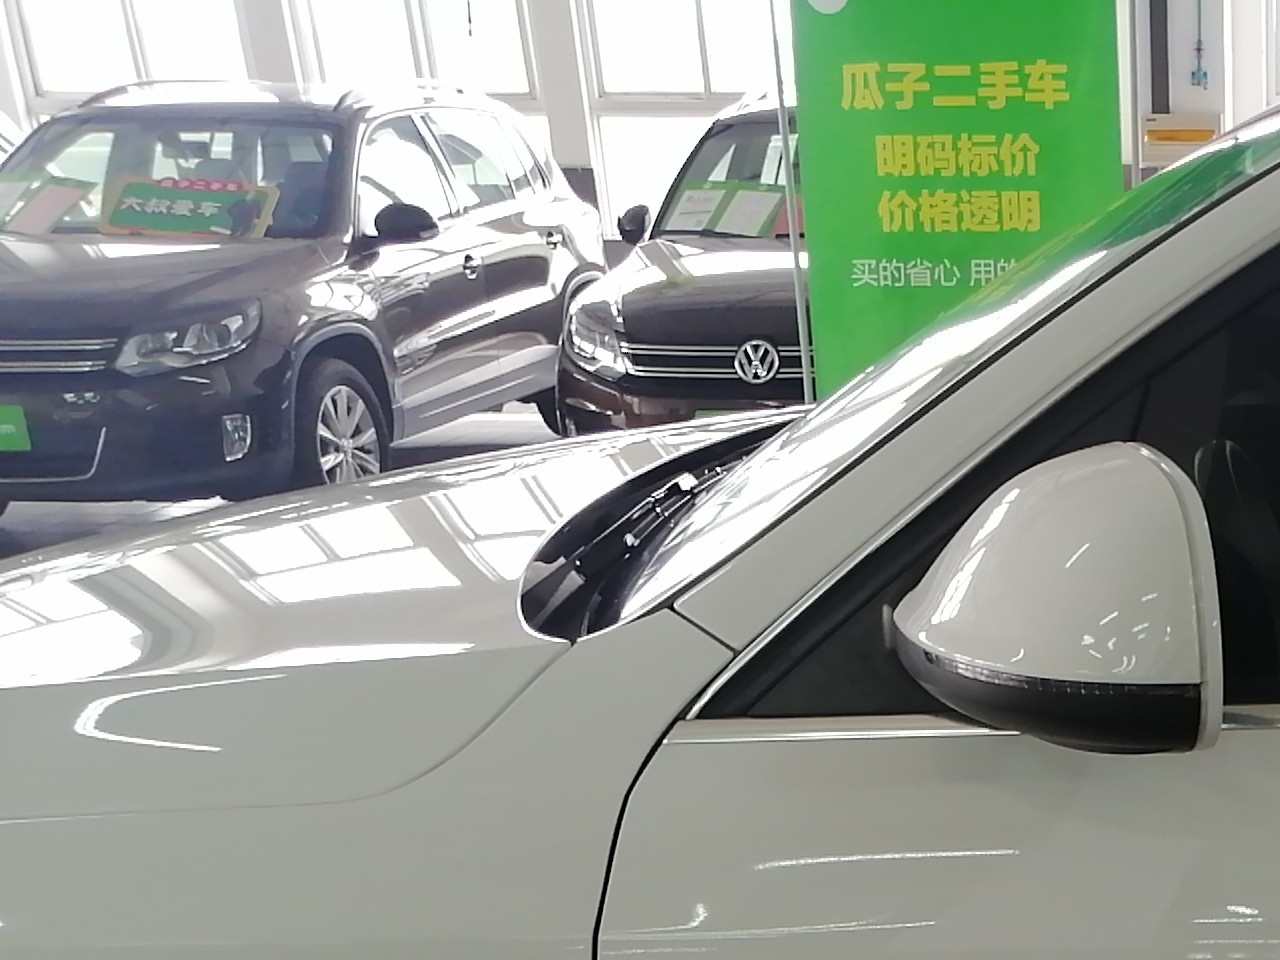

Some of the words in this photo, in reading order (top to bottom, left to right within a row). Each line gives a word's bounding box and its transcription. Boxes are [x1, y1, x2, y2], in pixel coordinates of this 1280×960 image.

[841, 59, 1070, 110] 瓜子二手车
[875, 133, 1040, 177] 明码标价
[878, 189, 1040, 232] 价格透明
[851, 257, 961, 287] 买的省心
